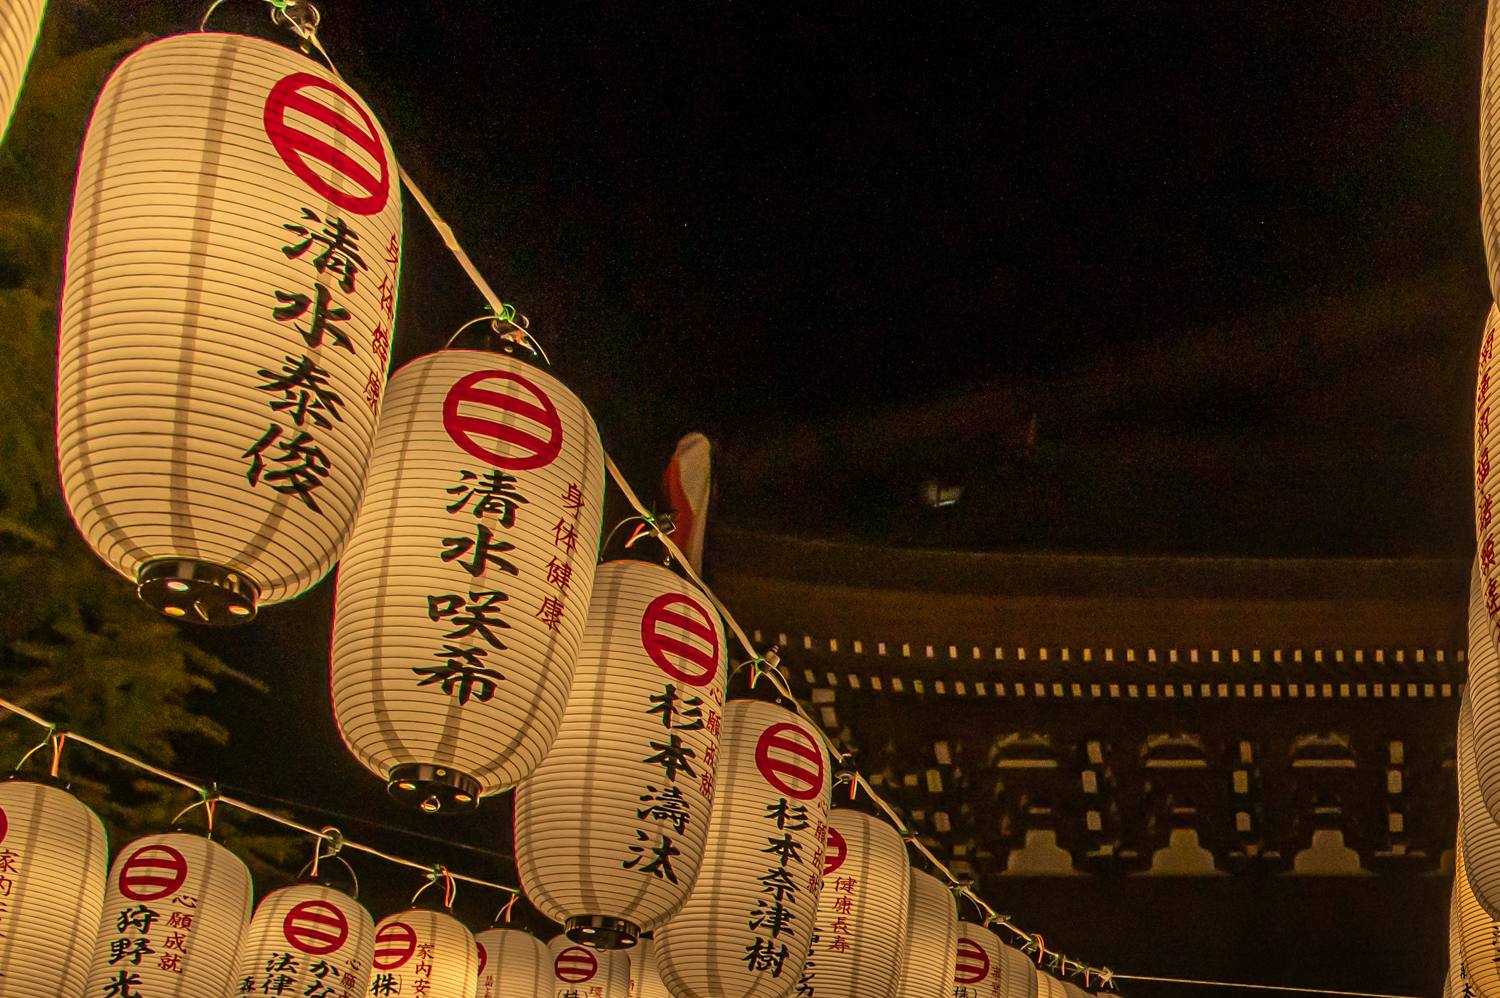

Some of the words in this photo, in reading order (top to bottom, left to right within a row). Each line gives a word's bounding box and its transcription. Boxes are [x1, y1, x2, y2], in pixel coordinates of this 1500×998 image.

[241, 206, 369, 516] 清水泰俊
[411, 469, 530, 707] 清水咲希
[535, 481, 588, 634] 身体健康
[157, 894, 198, 974] 心願成就
[742, 797, 810, 978] 杉本奈津樹
[829, 876, 858, 954] 健康長寿
